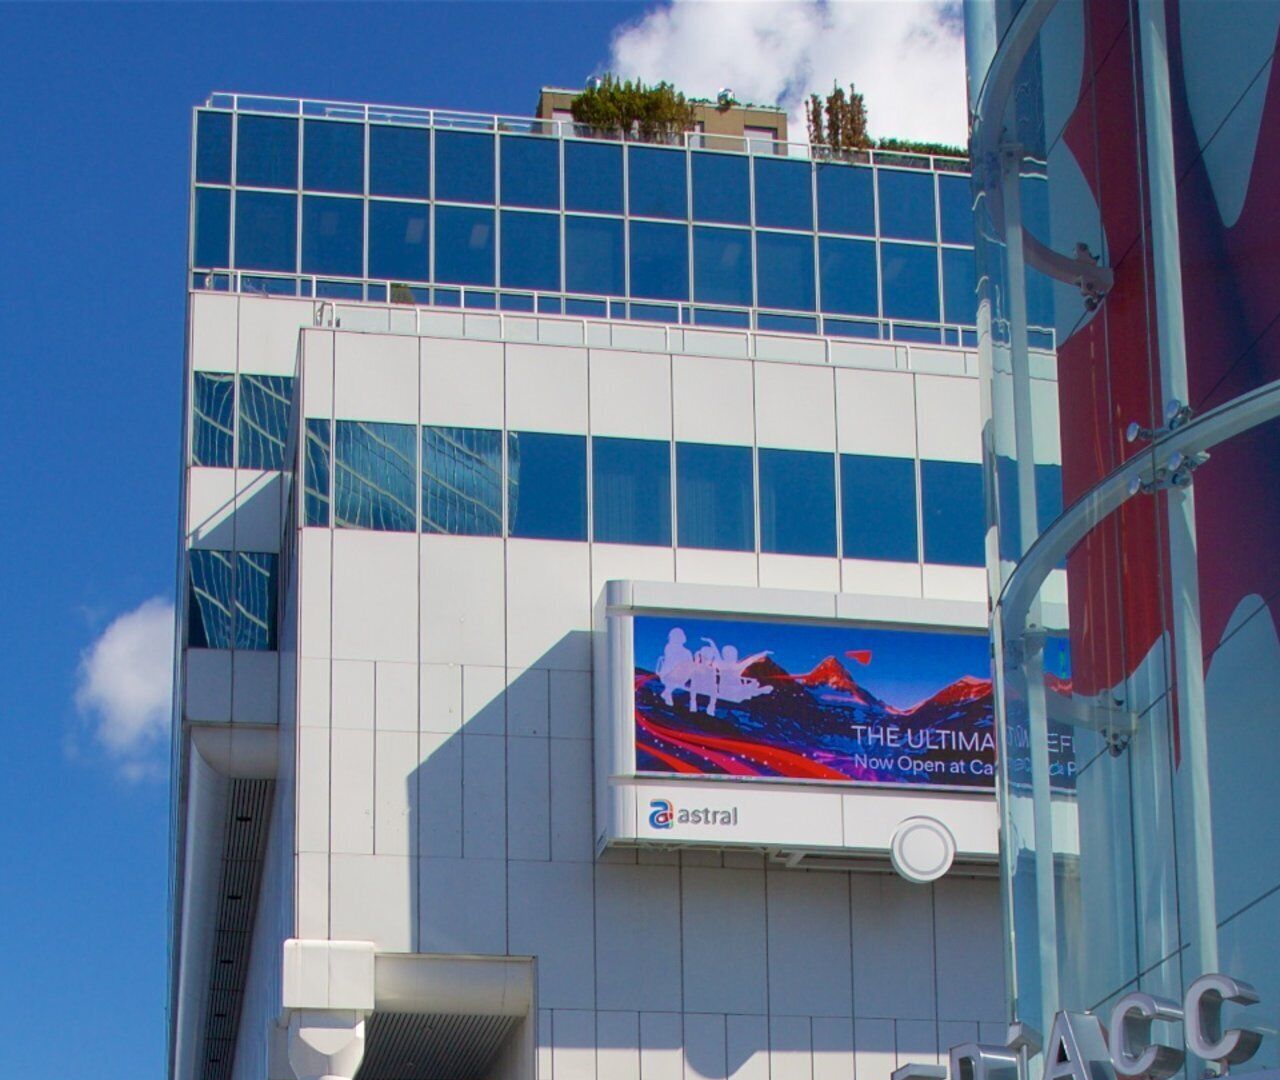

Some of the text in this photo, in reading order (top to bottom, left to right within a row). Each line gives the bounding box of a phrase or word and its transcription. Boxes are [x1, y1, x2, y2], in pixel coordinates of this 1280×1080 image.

[851, 725, 899, 748] THE
[854, 754, 894, 770] Now
[898, 756, 945, 775] Open
[950, 759, 965, 774] at
[677, 807, 738, 826] astral
